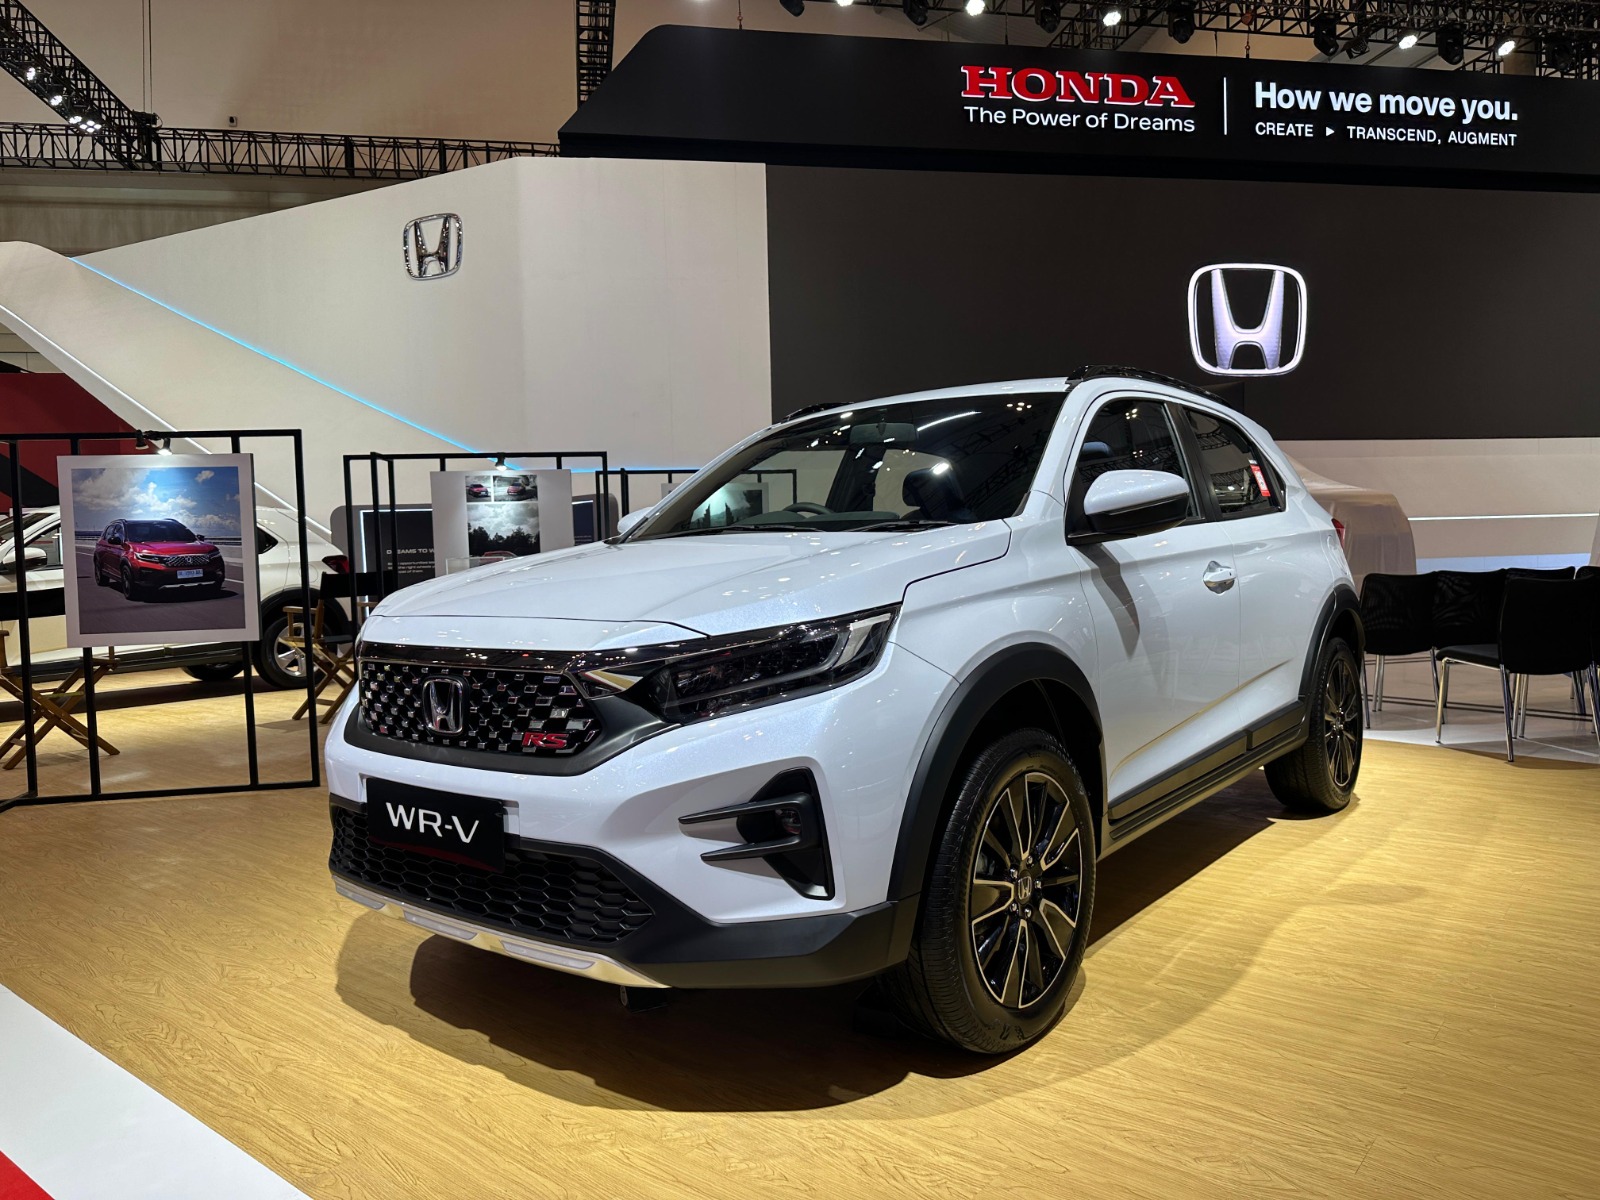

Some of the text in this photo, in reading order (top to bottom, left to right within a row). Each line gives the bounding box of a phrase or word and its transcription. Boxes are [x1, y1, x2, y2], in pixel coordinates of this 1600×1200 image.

[961, 66, 1195, 107] HONDA
[1255, 81, 1518, 124] How we move you.
[963, 106, 1196, 132] The Power of Dreams
[1255, 121, 1518, 146] CREATE TRANSCEND, AUGMENT
[522, 731, 569, 749] RS
[385, 801, 480, 844] WR-V
